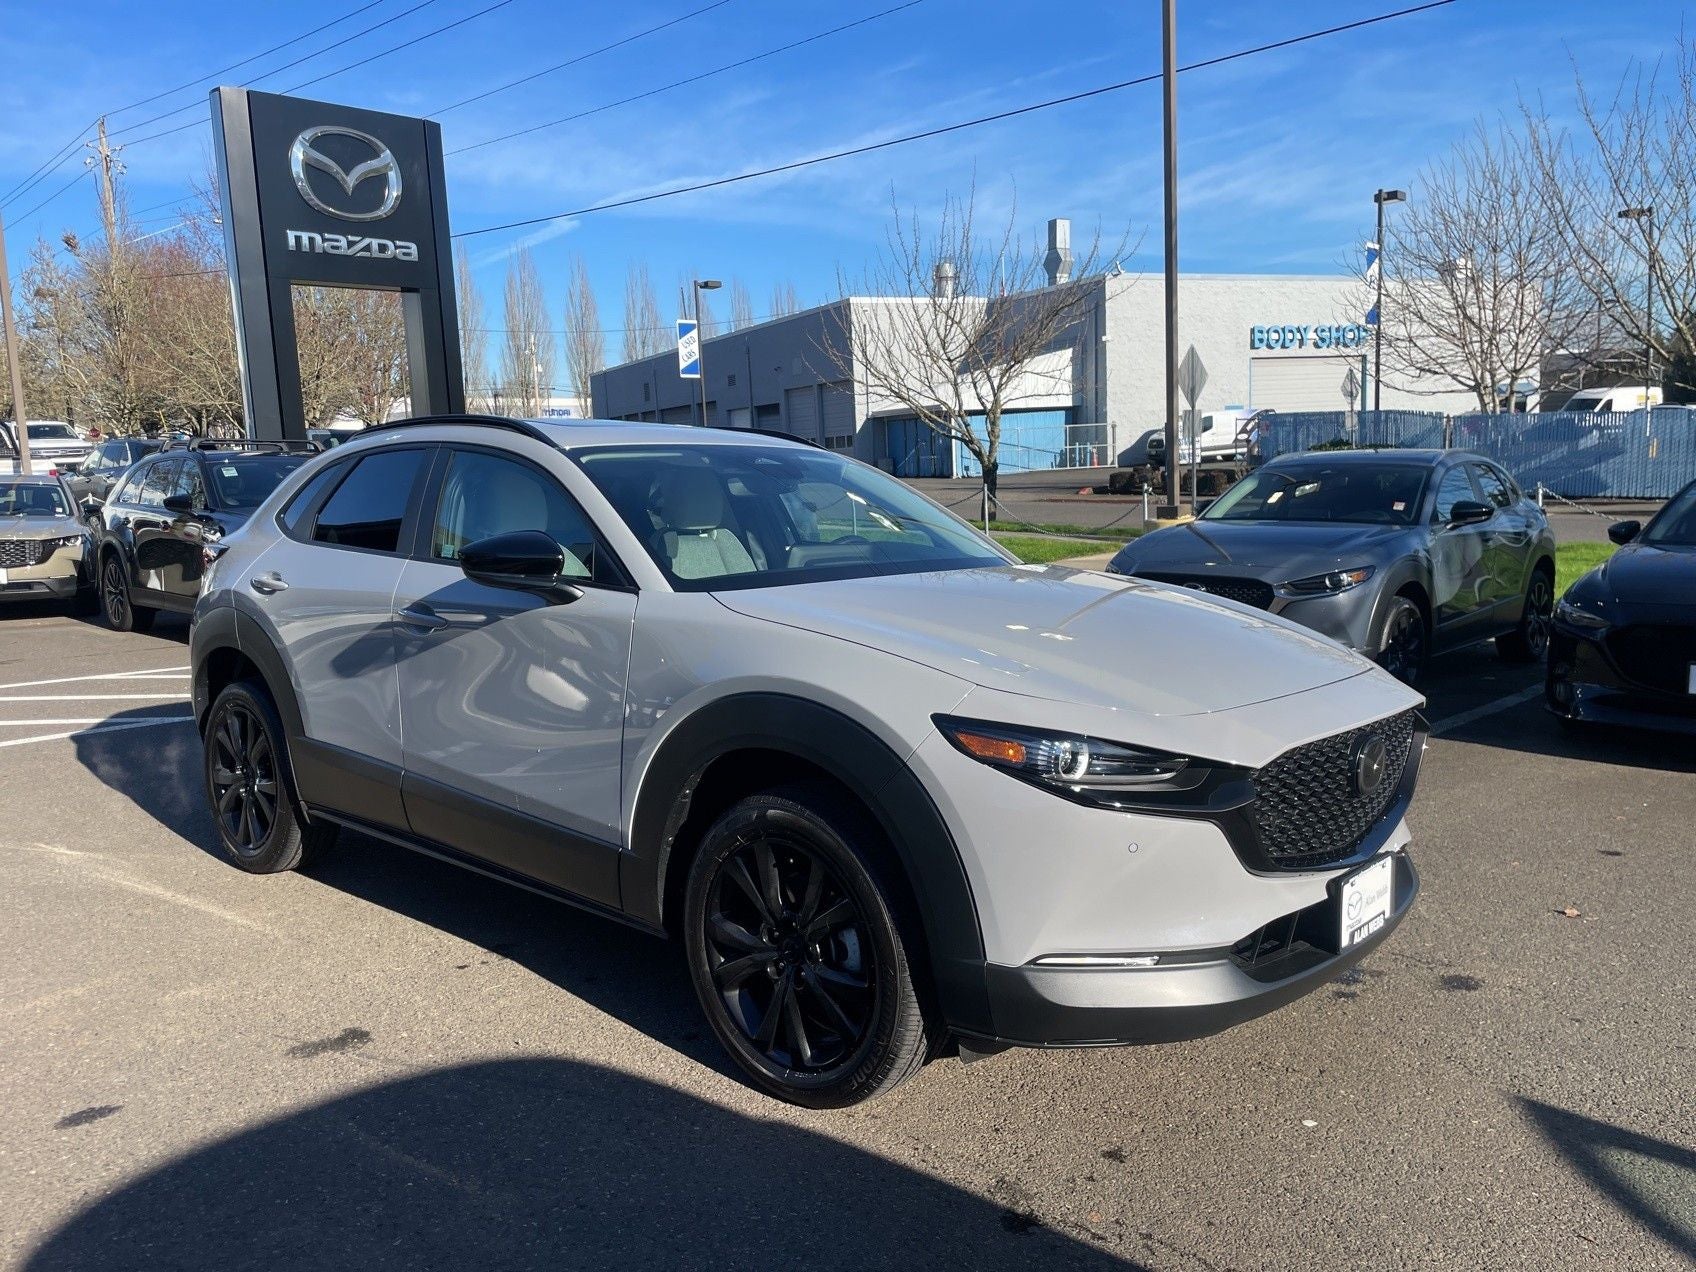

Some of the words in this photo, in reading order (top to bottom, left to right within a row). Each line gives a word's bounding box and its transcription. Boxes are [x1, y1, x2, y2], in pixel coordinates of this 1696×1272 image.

[681, 335, 696, 349] USED
[1250, 324, 1311, 350] BODY
[681, 349, 697, 363] CARS
